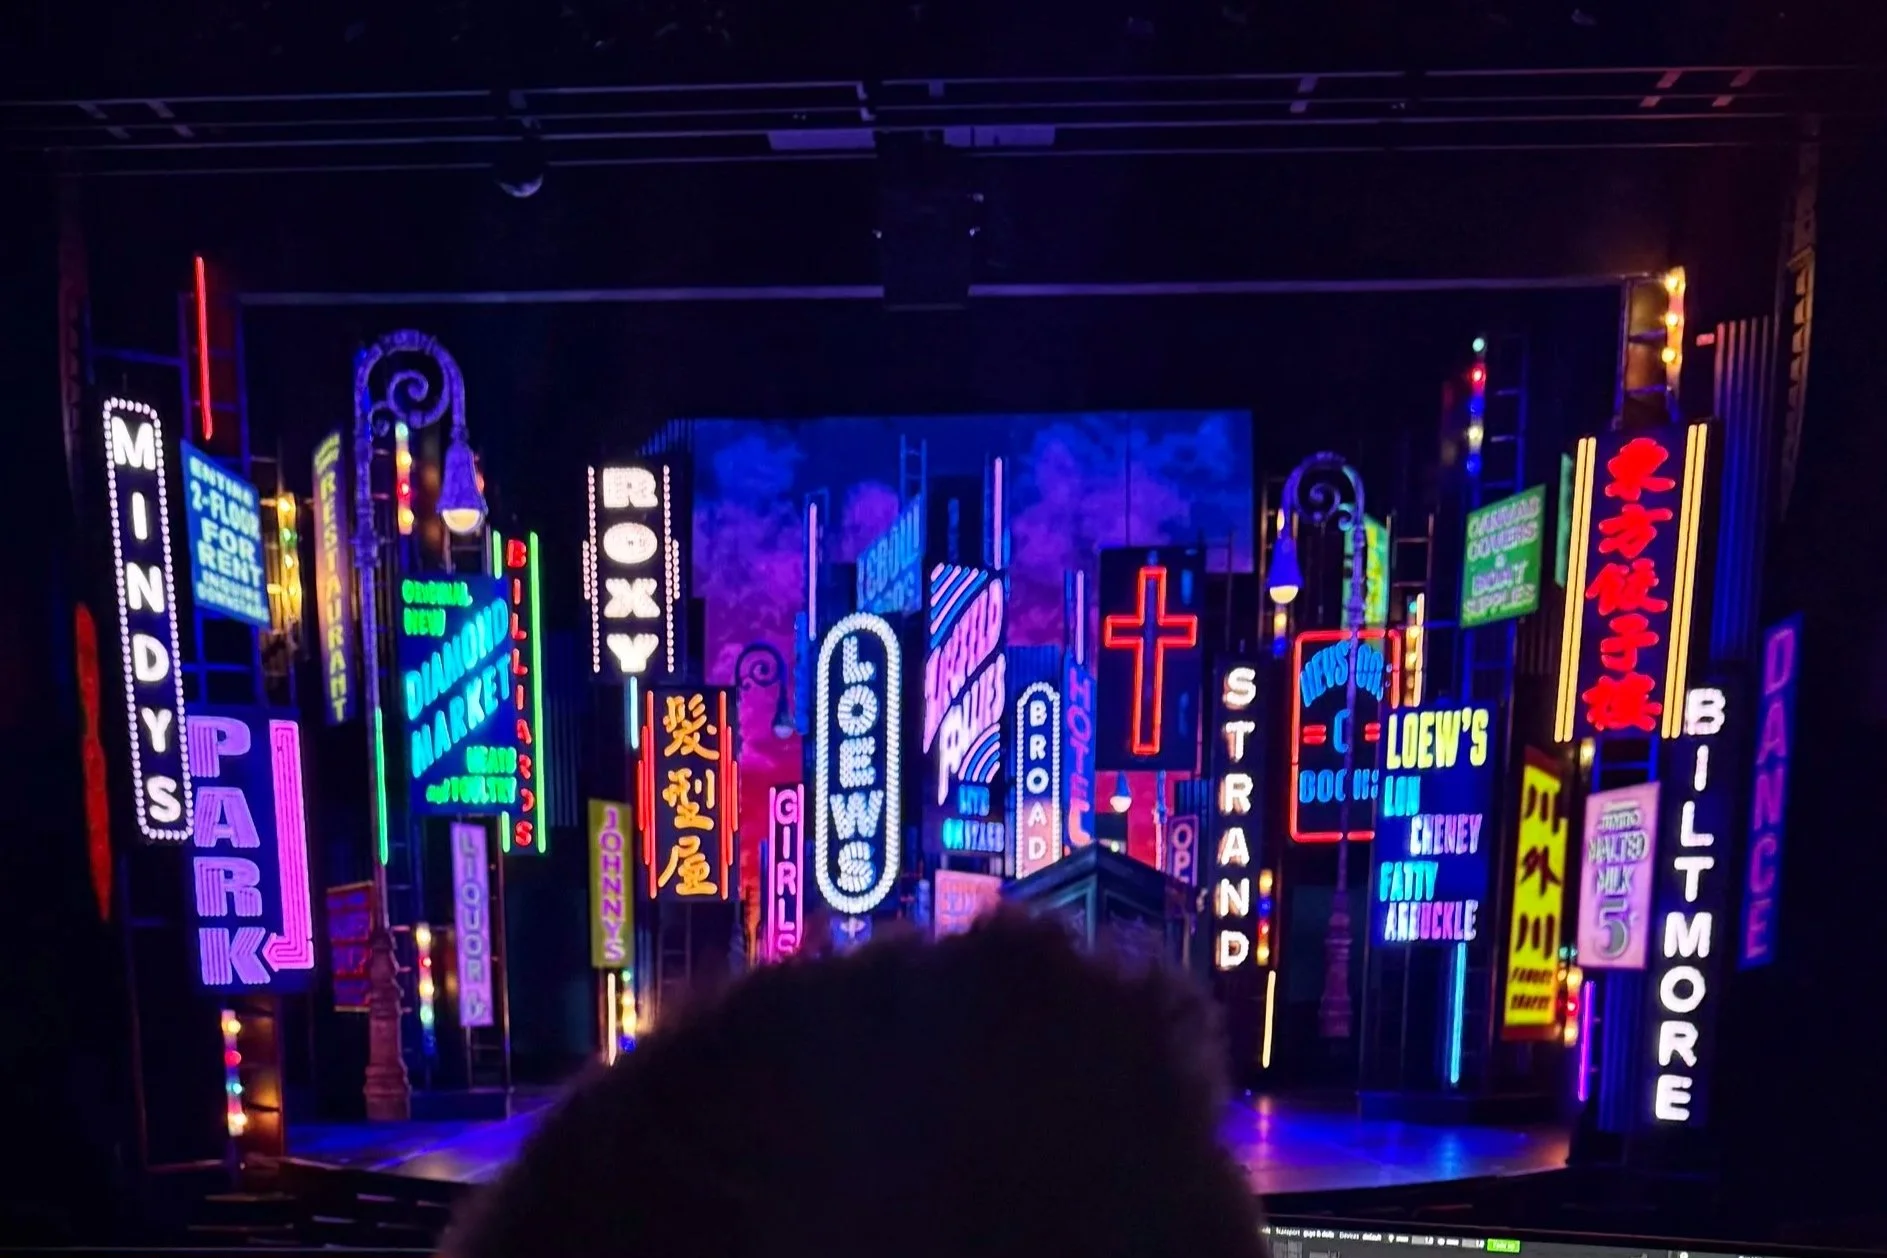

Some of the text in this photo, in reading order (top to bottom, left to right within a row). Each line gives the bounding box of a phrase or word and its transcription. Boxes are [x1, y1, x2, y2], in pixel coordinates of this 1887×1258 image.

[197, 539, 263, 587] RENT
[201, 517, 256, 563] FOR
[320, 470, 348, 723] RESTAURANT
[603, 466, 661, 673] ROXY
[111, 416, 181, 823] MINDYS
[405, 598, 509, 721] DIAMOND
[507, 538, 535, 848] BILLIARDS
[412, 653, 511, 778] MARKET
[830, 635, 884, 893] LOEWS
[1026, 700, 1050, 861] BROAD
[1067, 668, 1092, 847] HOTEL
[1386, 708, 1489, 770] LOEW'S
[1744, 627, 1795, 959] DANCE
[188, 715, 271, 985] PARK
[1215, 667, 1257, 970] STRAND
[1384, 775, 1421, 817] LON
[1410, 813, 1483, 856] CHENEY
[599, 806, 625, 962] JOHNNYS
[1379, 861, 1439, 902] FATTY
[1384, 899, 1479, 942] ARBUCKLE
[1595, 865, 1635, 896] MILK
[1656, 687, 1726, 1121] BILTMORE
